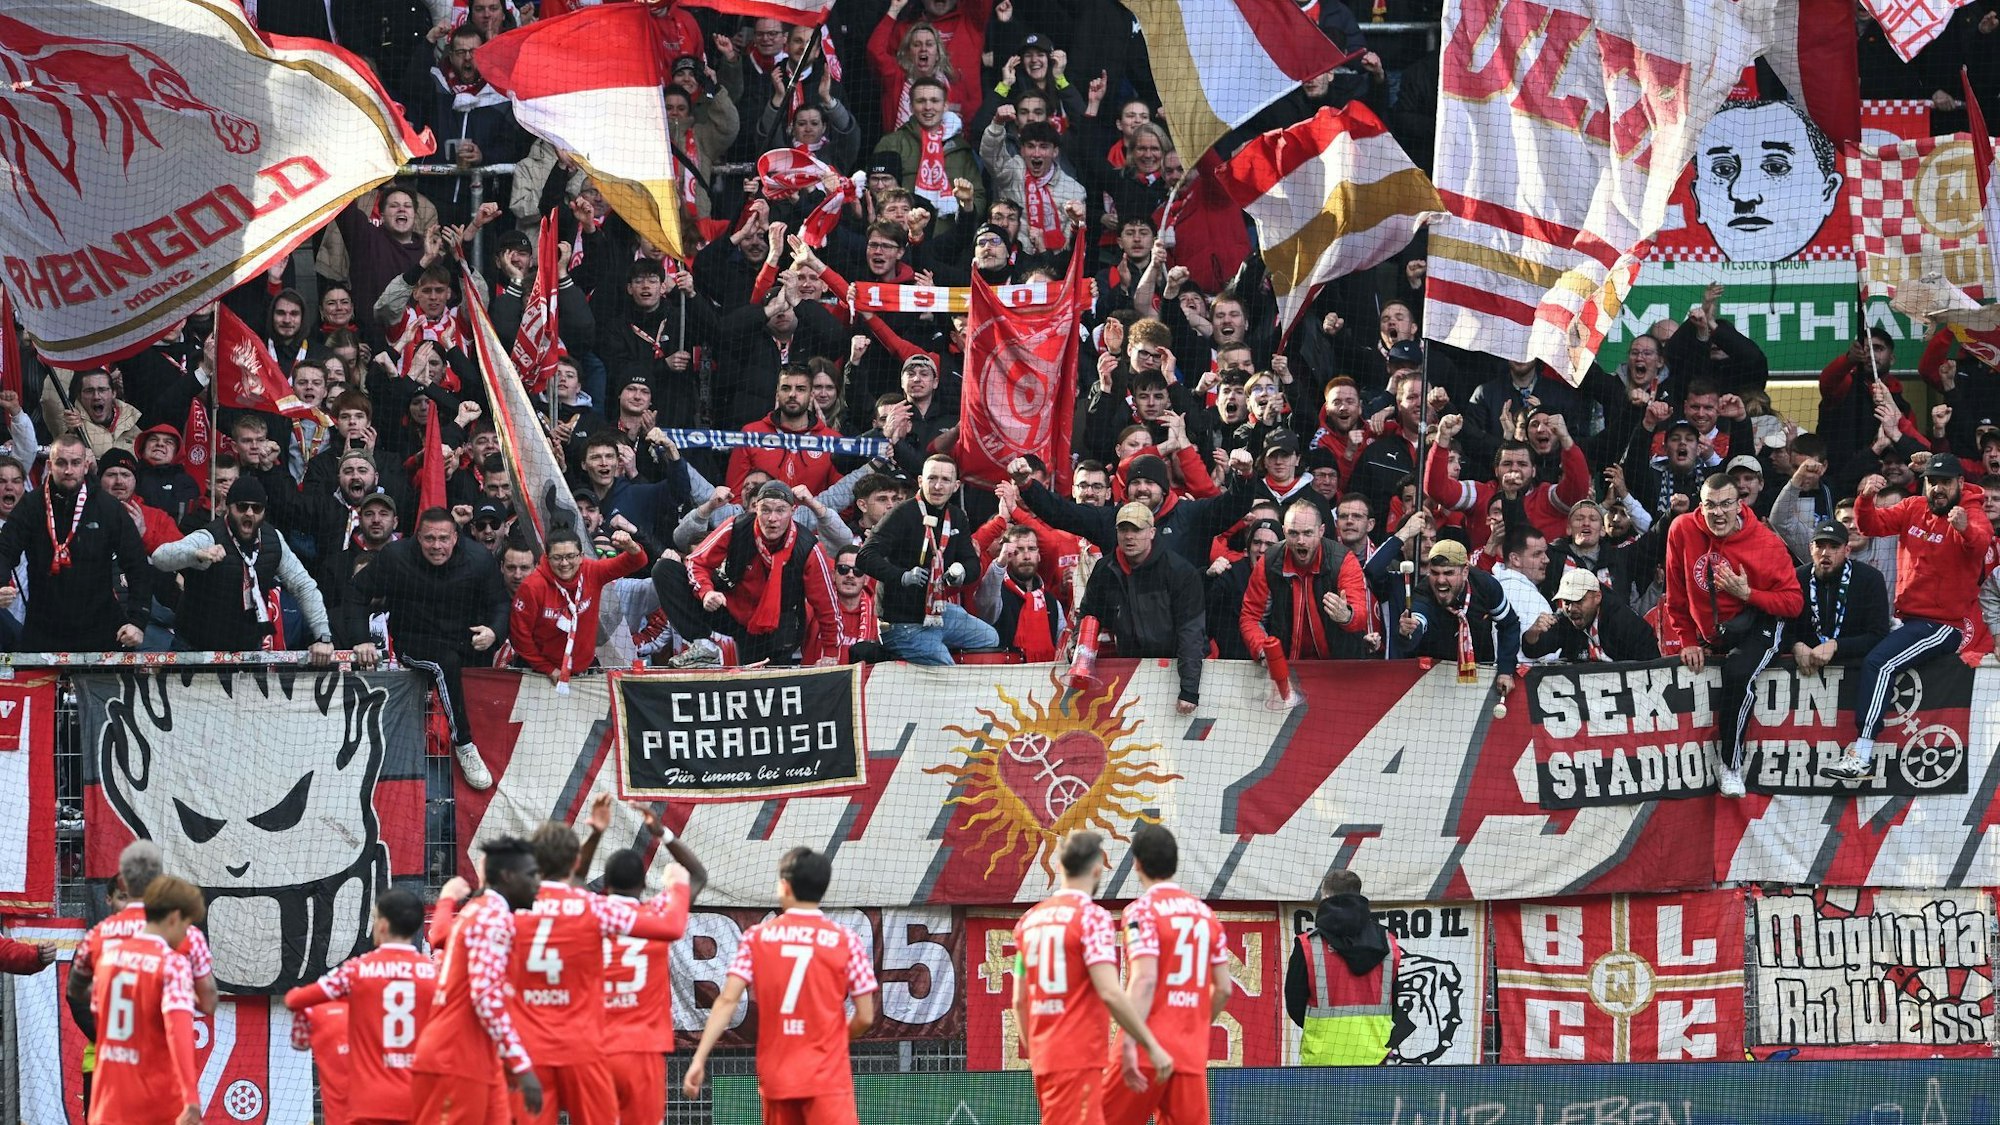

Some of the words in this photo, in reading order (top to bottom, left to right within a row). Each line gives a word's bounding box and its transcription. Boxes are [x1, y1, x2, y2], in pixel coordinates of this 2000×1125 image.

[125, 269, 196, 312] MAINZ
[671, 686, 802, 723] CURVA
[1537, 664, 1846, 739] SEKTON
[641, 721, 838, 760] PARADISO
[1548, 738, 1898, 800] STADIONVERBT
[664, 766, 697, 785] Für
[702, 769, 752, 783] immer
[757, 764, 780, 780] bei
[785, 760, 821, 777] uns!
[526, 918, 564, 986] 4
[760, 926, 814, 943] MAINZ
[816, 929, 840, 947] 05
[1166, 916, 1211, 989] 31
[1754, 893, 1988, 986] Moguntia
[359, 962, 414, 980] MAINZ
[780, 943, 815, 1015] 7
[106, 971, 138, 1042] 6
[382, 980, 416, 1049] 8
[783, 1019, 806, 1035] LEE
